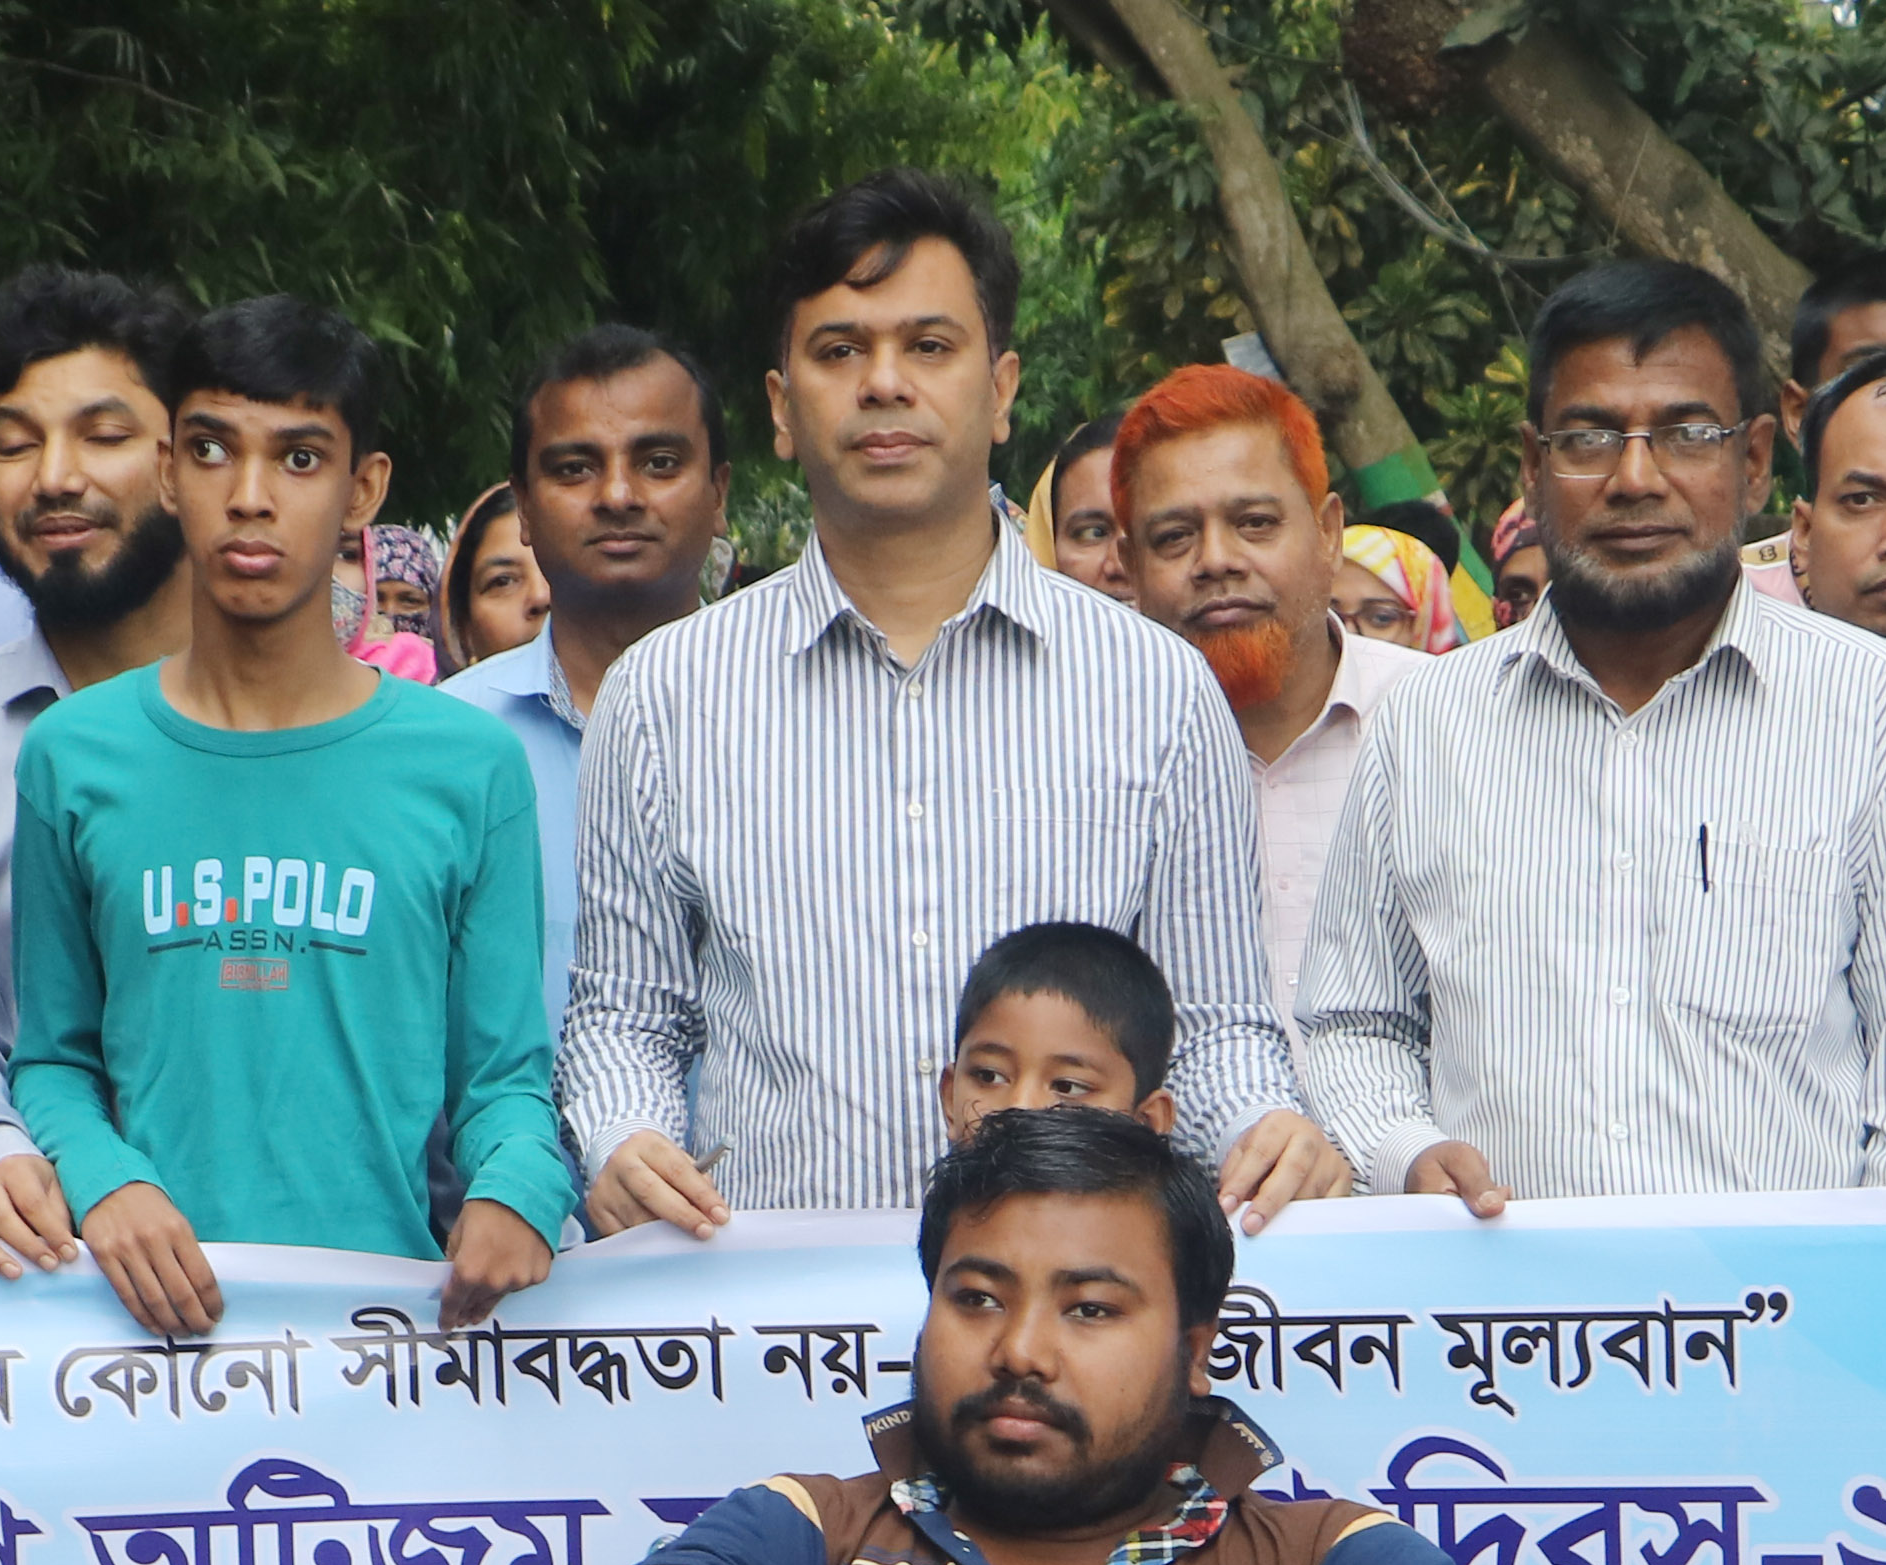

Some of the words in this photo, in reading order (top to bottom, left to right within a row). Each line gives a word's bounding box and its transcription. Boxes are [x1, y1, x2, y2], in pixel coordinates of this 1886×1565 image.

[203, 930, 306, 953] ASSN.
[56, 1329, 311, 1419] কোনো
[341, 1308, 732, 1408] সীমাবদ্ধতা
